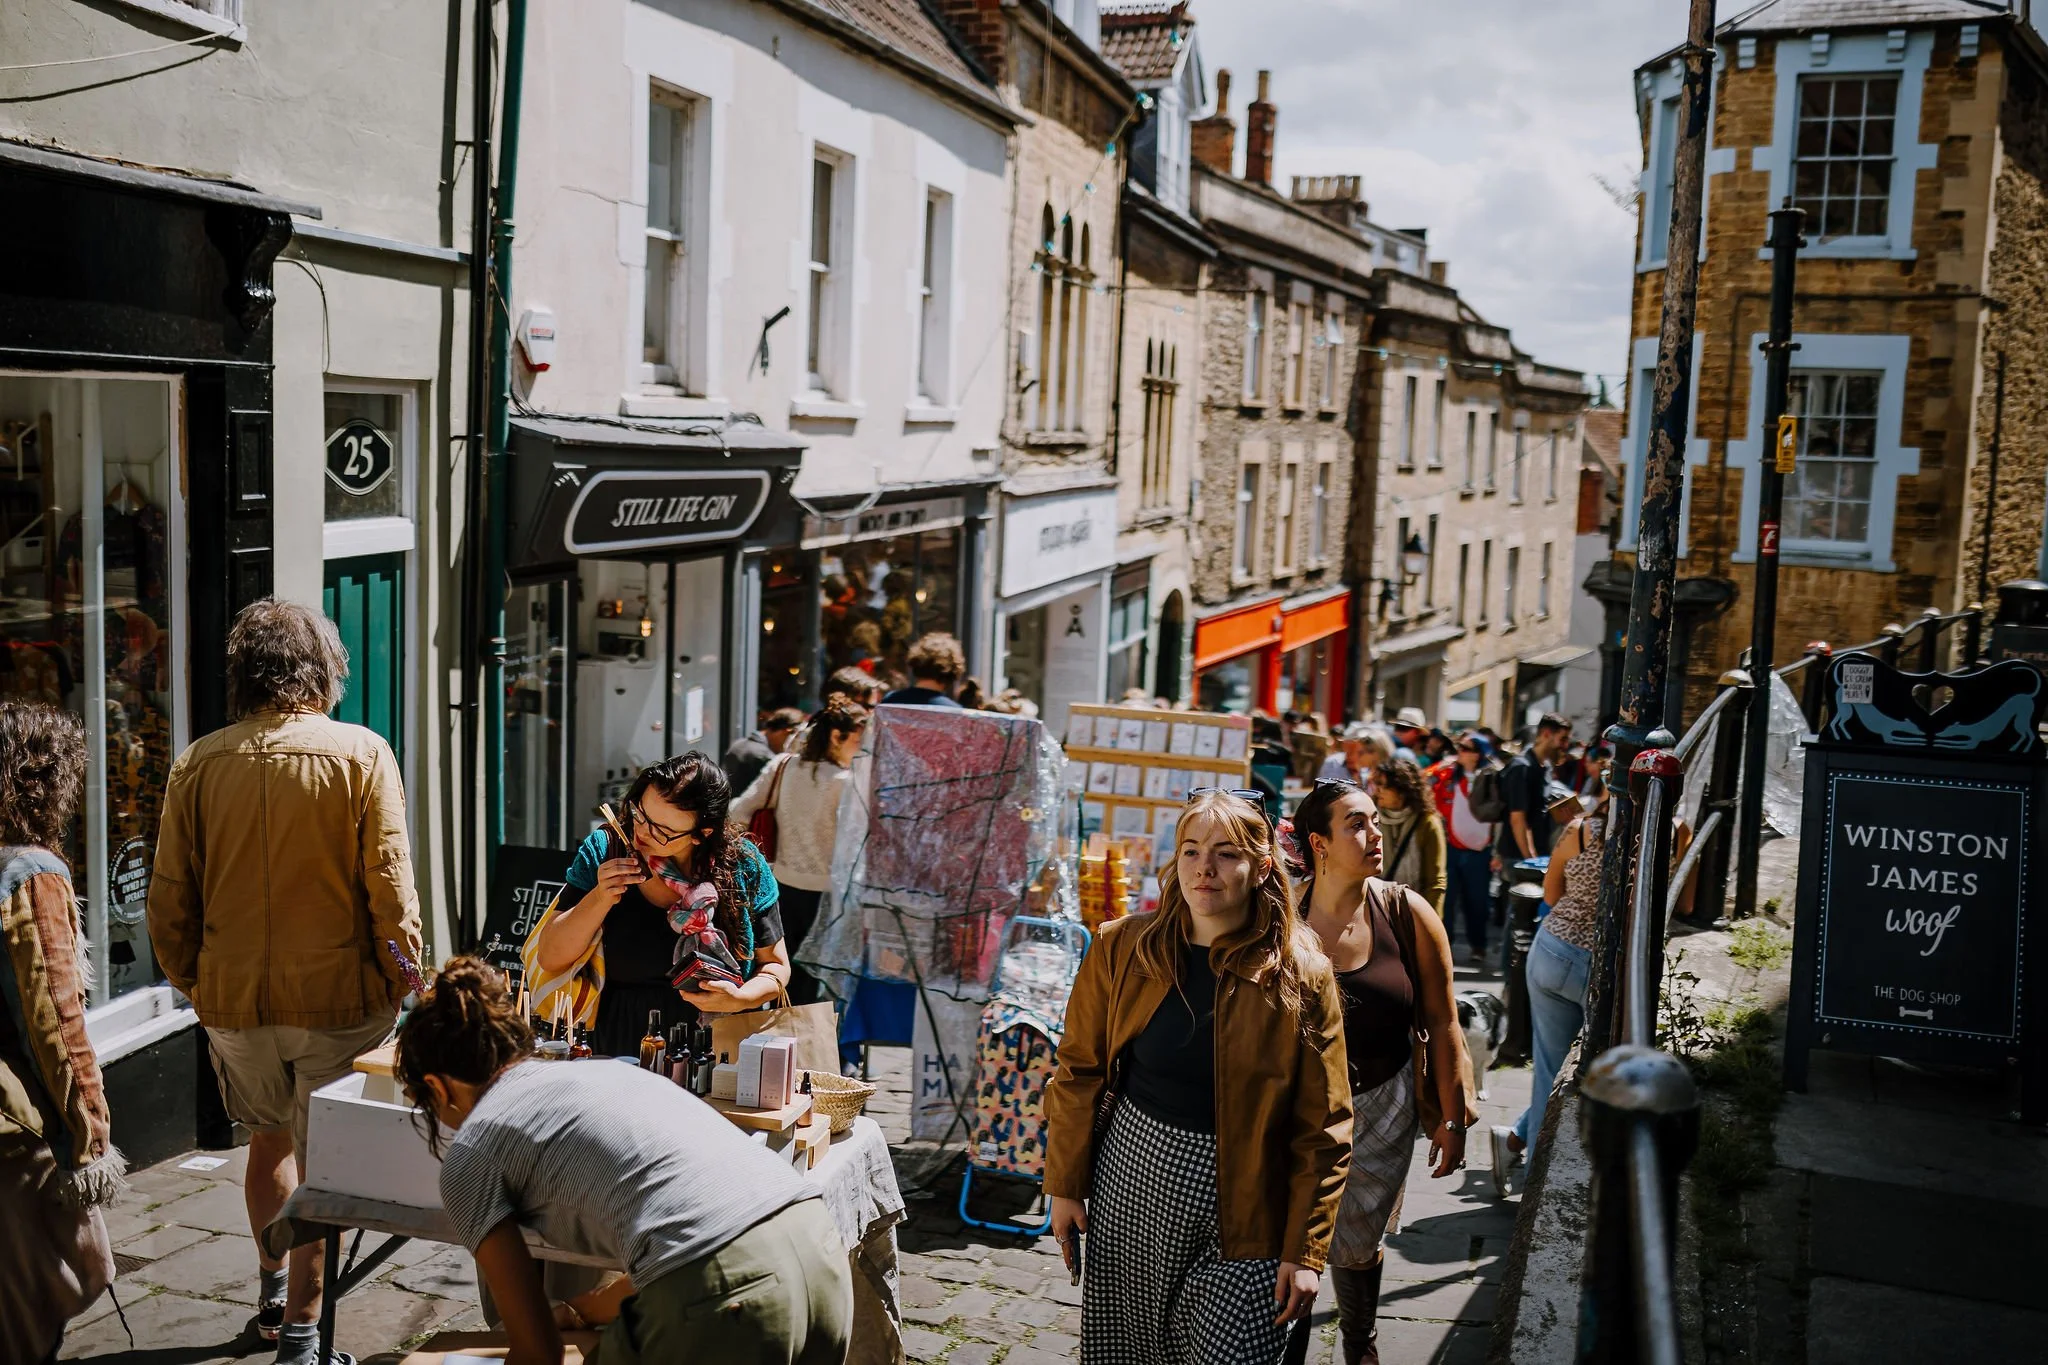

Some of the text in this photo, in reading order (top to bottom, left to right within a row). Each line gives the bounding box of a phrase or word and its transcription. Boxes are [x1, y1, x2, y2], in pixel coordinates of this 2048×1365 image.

[343, 435, 374, 479] 25
[610, 494, 738, 527] STILL LIFE GIN
[1843, 824, 2008, 860] WINSTON
[124, 888, 148, 904] OPERATE
[1866, 864, 1978, 896] JAMES
[511, 920, 536, 936] GI
[1885, 905, 1961, 957] woof
[1873, 985, 1961, 1006] THE DOG SHOP
